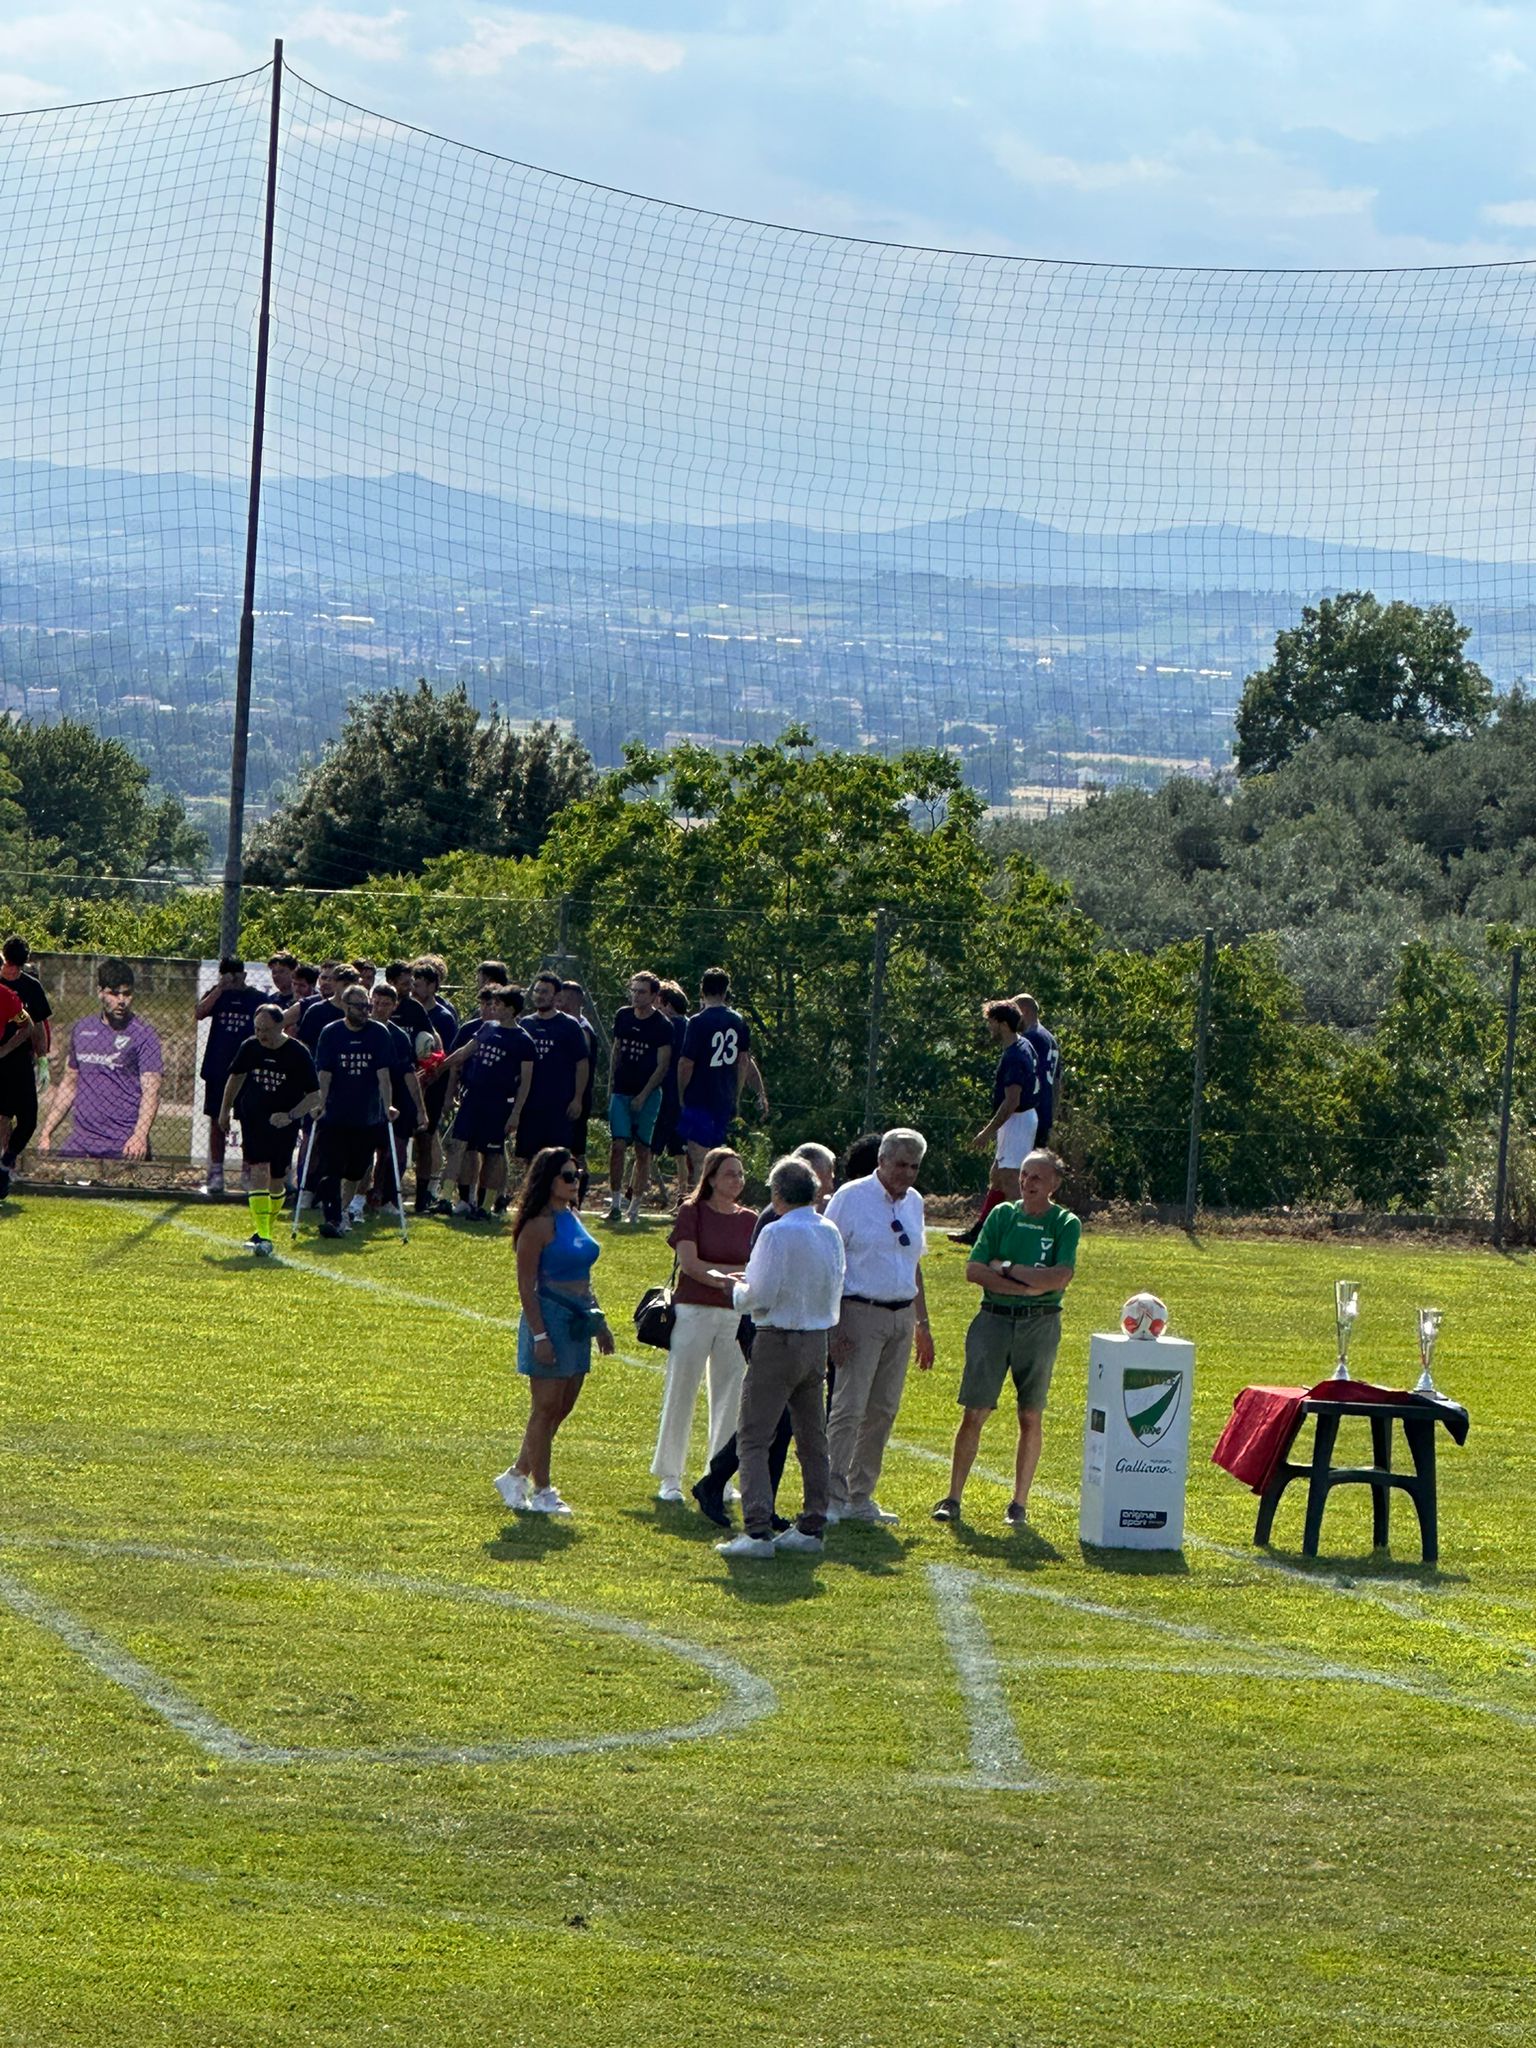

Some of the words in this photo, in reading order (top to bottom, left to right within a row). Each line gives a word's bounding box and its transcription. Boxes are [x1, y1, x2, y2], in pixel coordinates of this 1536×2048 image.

[709, 1027, 739, 1068] 23
[1115, 1457, 1170, 1474] Galliano
[1121, 1519, 1148, 1528] sport
